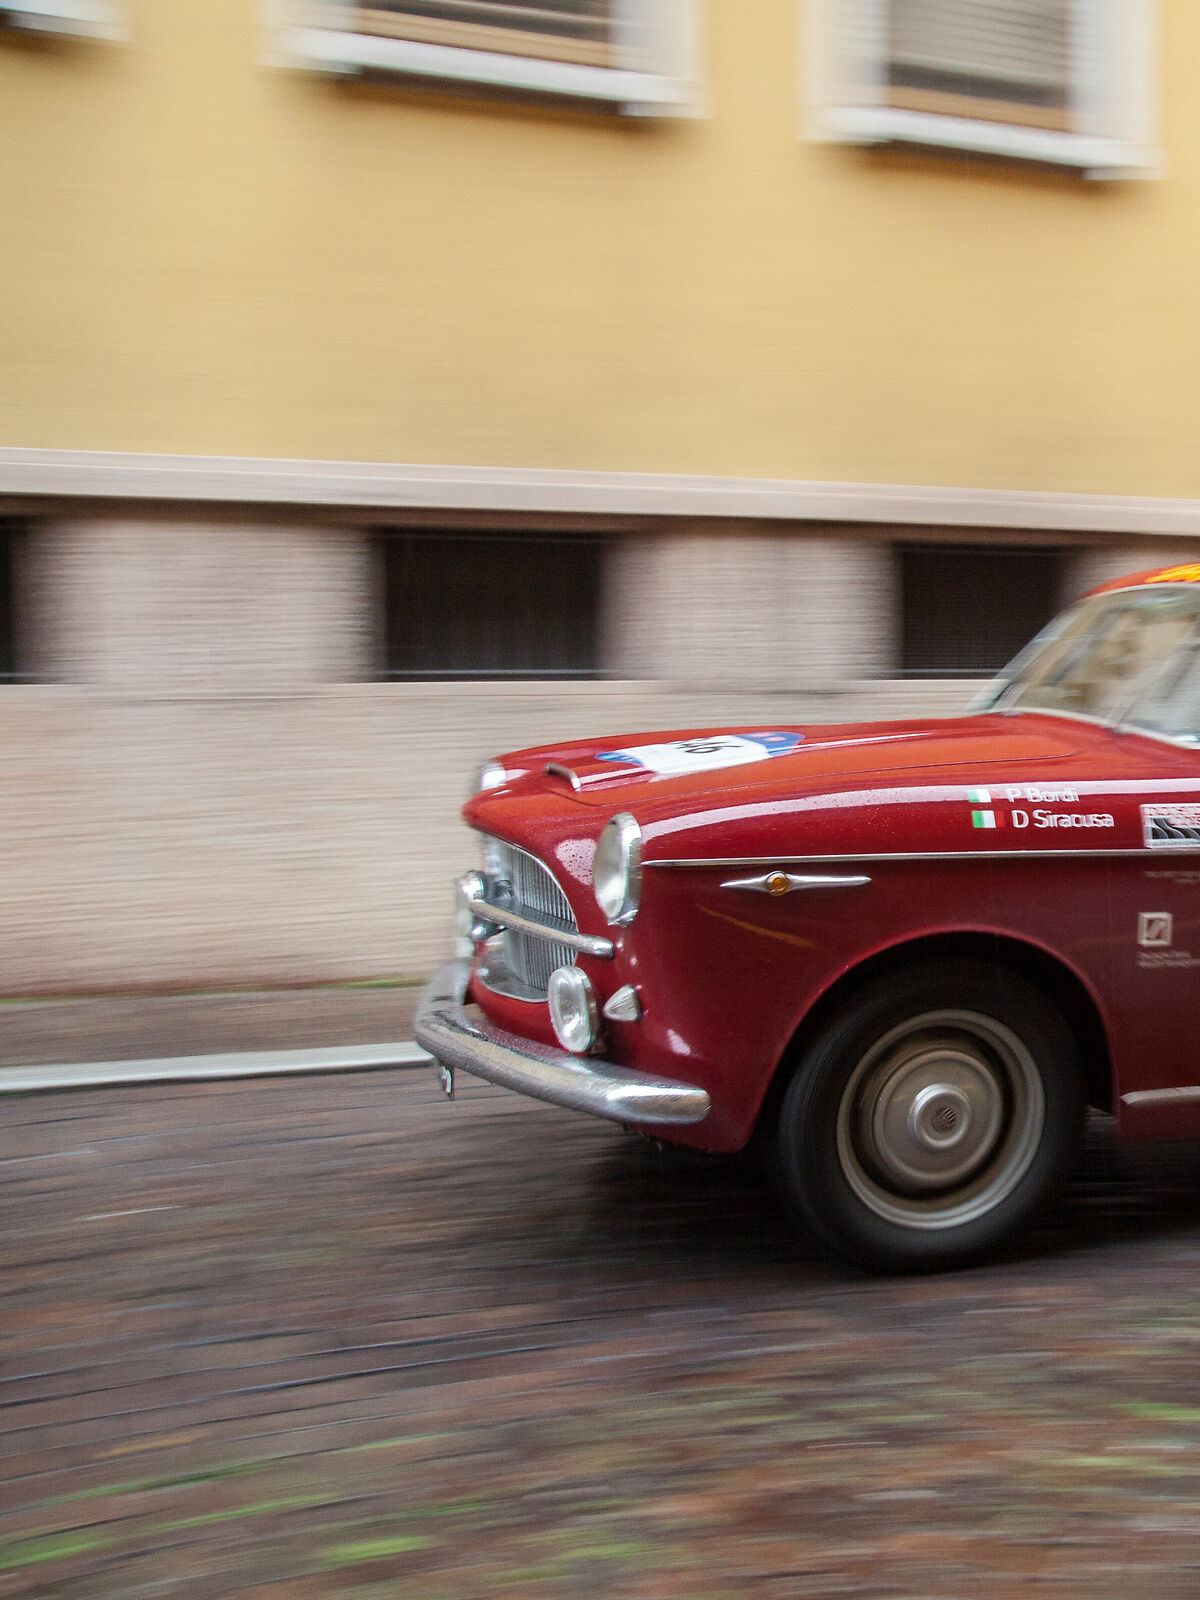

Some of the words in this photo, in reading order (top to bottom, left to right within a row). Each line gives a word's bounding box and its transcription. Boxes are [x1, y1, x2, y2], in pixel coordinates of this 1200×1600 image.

[1006, 788, 1022, 802] P
[1025, 787, 1079, 802] Bordi
[1011, 810, 1029, 828] D
[1033, 809, 1114, 828] Siracusa
